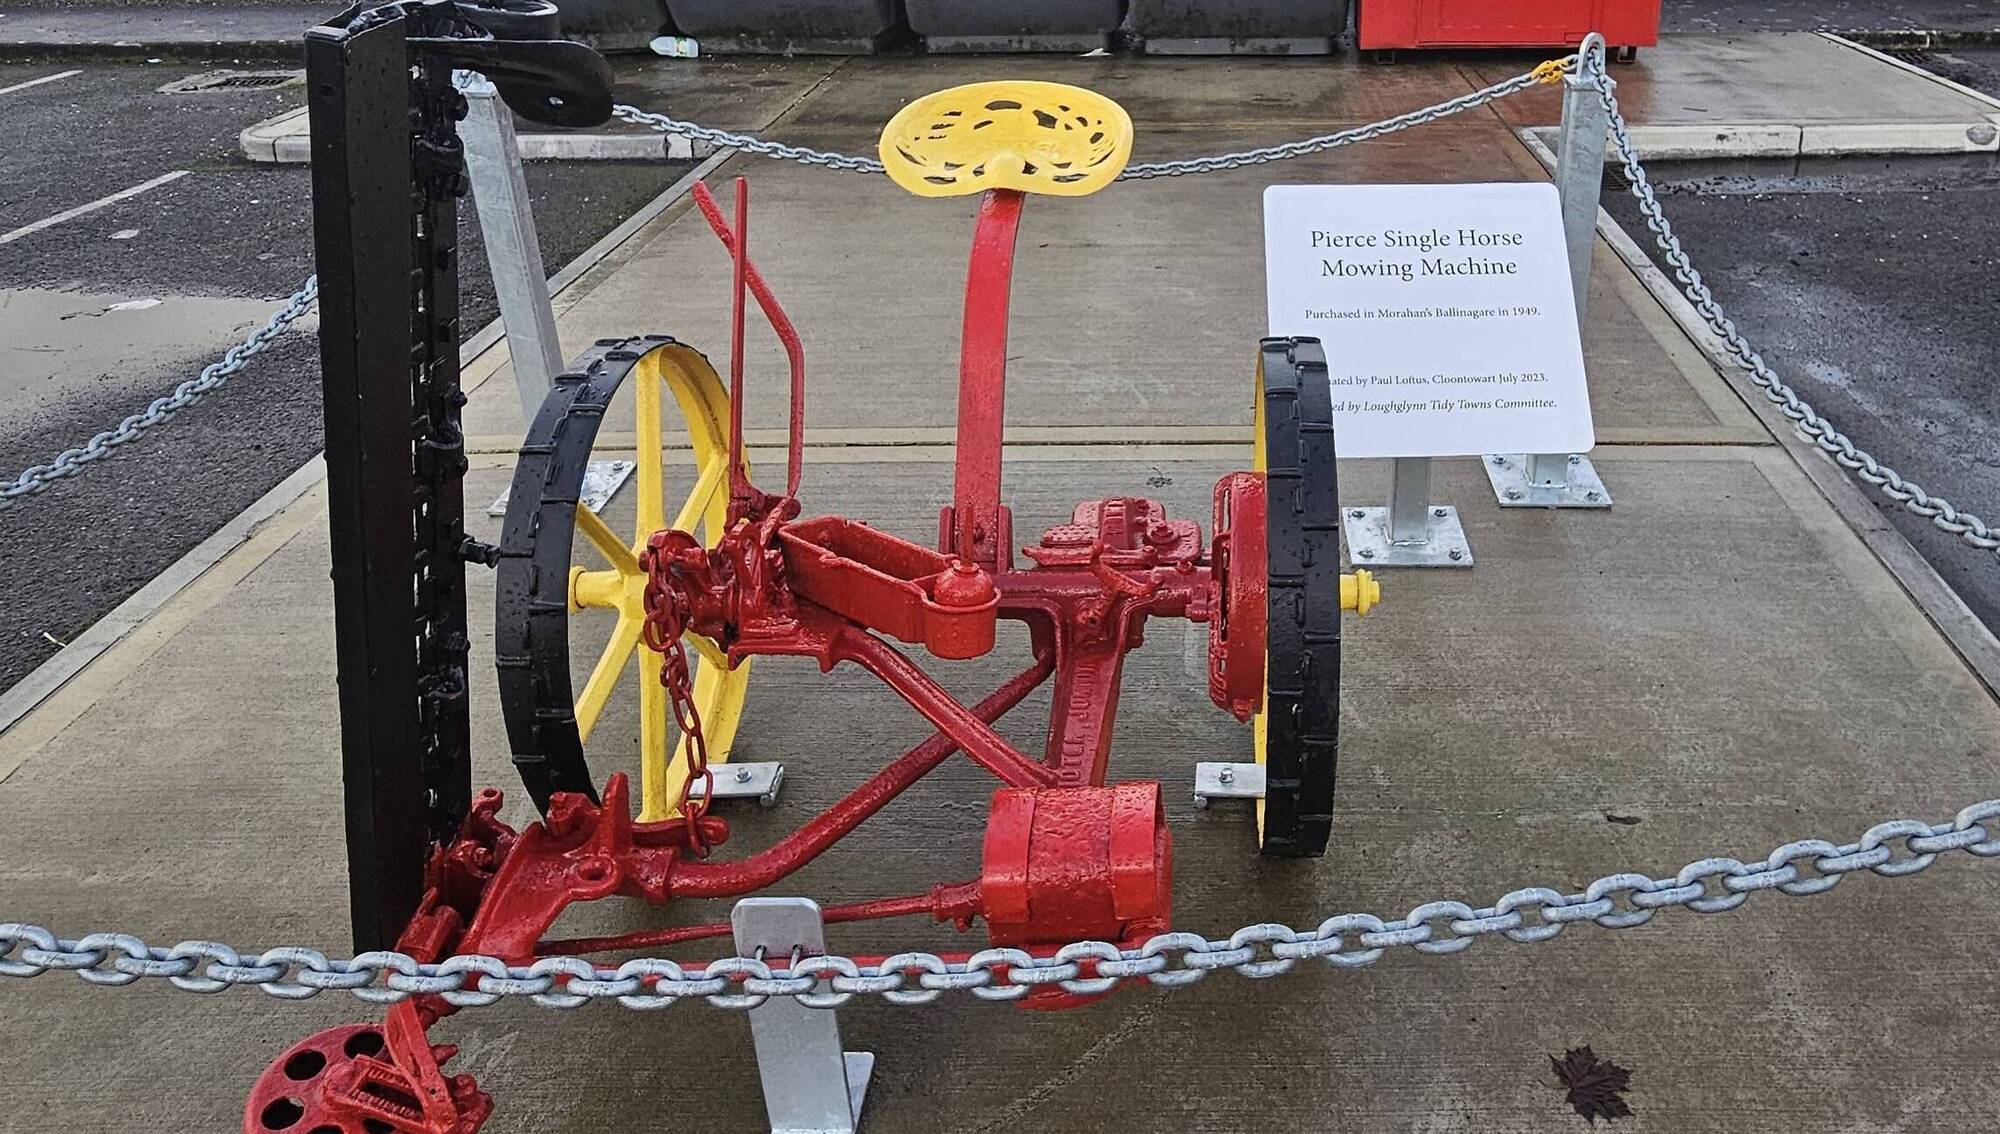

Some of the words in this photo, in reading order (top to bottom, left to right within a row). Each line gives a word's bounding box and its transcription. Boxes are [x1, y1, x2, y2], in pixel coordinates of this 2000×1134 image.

[1311, 231, 1376, 247] Pierce
[1385, 229, 1450, 252] Single
[1458, 230, 1522, 246] Horse
[1322, 260, 1413, 281] Mowing
[1421, 257, 1517, 275] Machine
[1306, 309, 1360, 319] Purchased
[1364, 310, 1374, 318] in
[1378, 308, 1432, 318] Morahan's
[1436, 307, 1495, 319] Ballinagare
[1498, 308, 1509, 316] in
[1513, 307, 1540, 315] 1949.
[1356, 376, 1367, 387] by
[1371, 376, 1392, 384] Paul
[1396, 375, 1429, 384] Loftus,
[1432, 375, 1496, 384] Cloontowart
[1499, 373, 1518, 384] July
[1521, 373, 1548, 382] 2023.
[1348, 401, 1361, 414] by
[1364, 400, 1426, 414] Loughglynn
[1430, 399, 1454, 413] Tidy
[1458, 399, 1491, 409] Towns
[1495, 399, 1556, 408] Committee.
